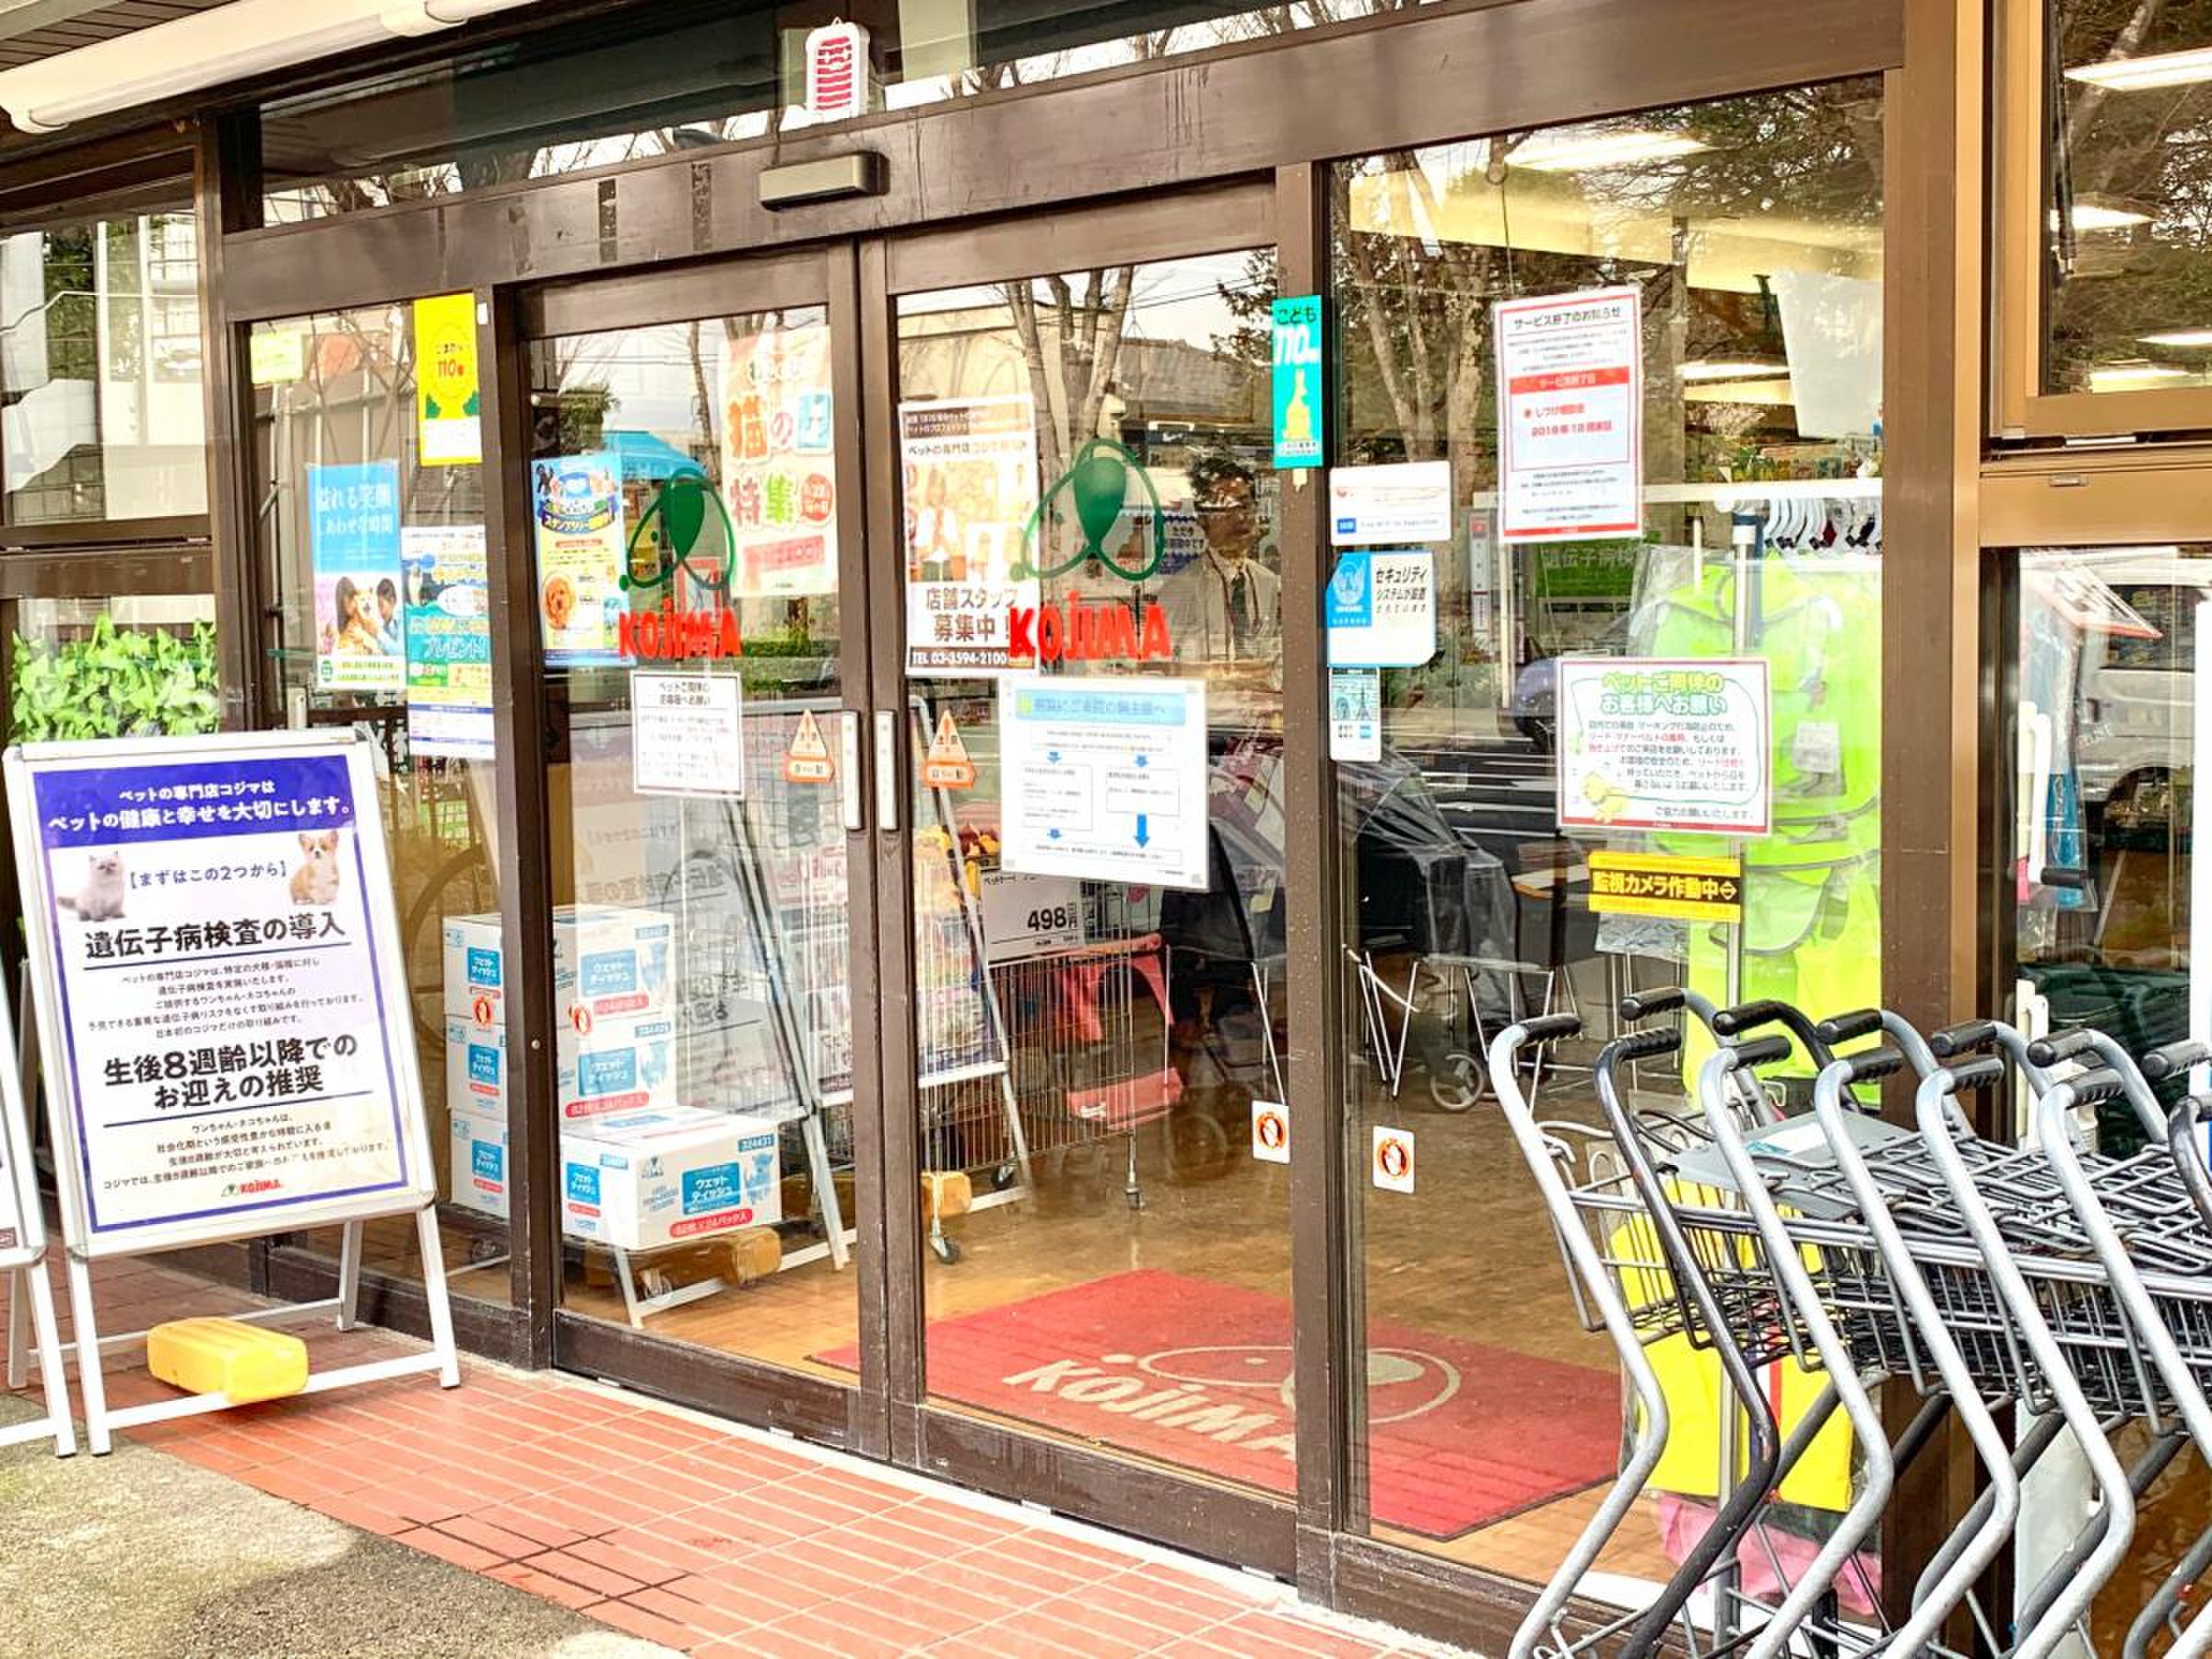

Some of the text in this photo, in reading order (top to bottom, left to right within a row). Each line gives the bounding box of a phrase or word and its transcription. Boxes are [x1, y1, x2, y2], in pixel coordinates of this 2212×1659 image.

[1276, 307, 1317, 324] こども
[1514, 307, 1620, 329] サービス終了のお知らせ
[729, 475, 795, 526] 特集
[1375, 565, 1429, 583] セキュリティ
[924, 587, 1019, 610] 店舗スタッフ
[912, 648, 1007, 665] TEL 03-3594-2100
[1600, 693, 1728, 715] お客様へお願い
[118, 781, 276, 802] ペットの専門店コジマは
[48, 796, 351, 831] ペットの健康と幸せを大切にします。
[1591, 873, 1720, 900] 監視カメラ作動中
[1027, 907, 1067, 931] 498
[83, 910, 347, 960] 遺伝子病検査の導入
[103, 1033, 359, 1088] 生後8週齢以降での
[153, 1064, 325, 1111] お迎えの推奨
